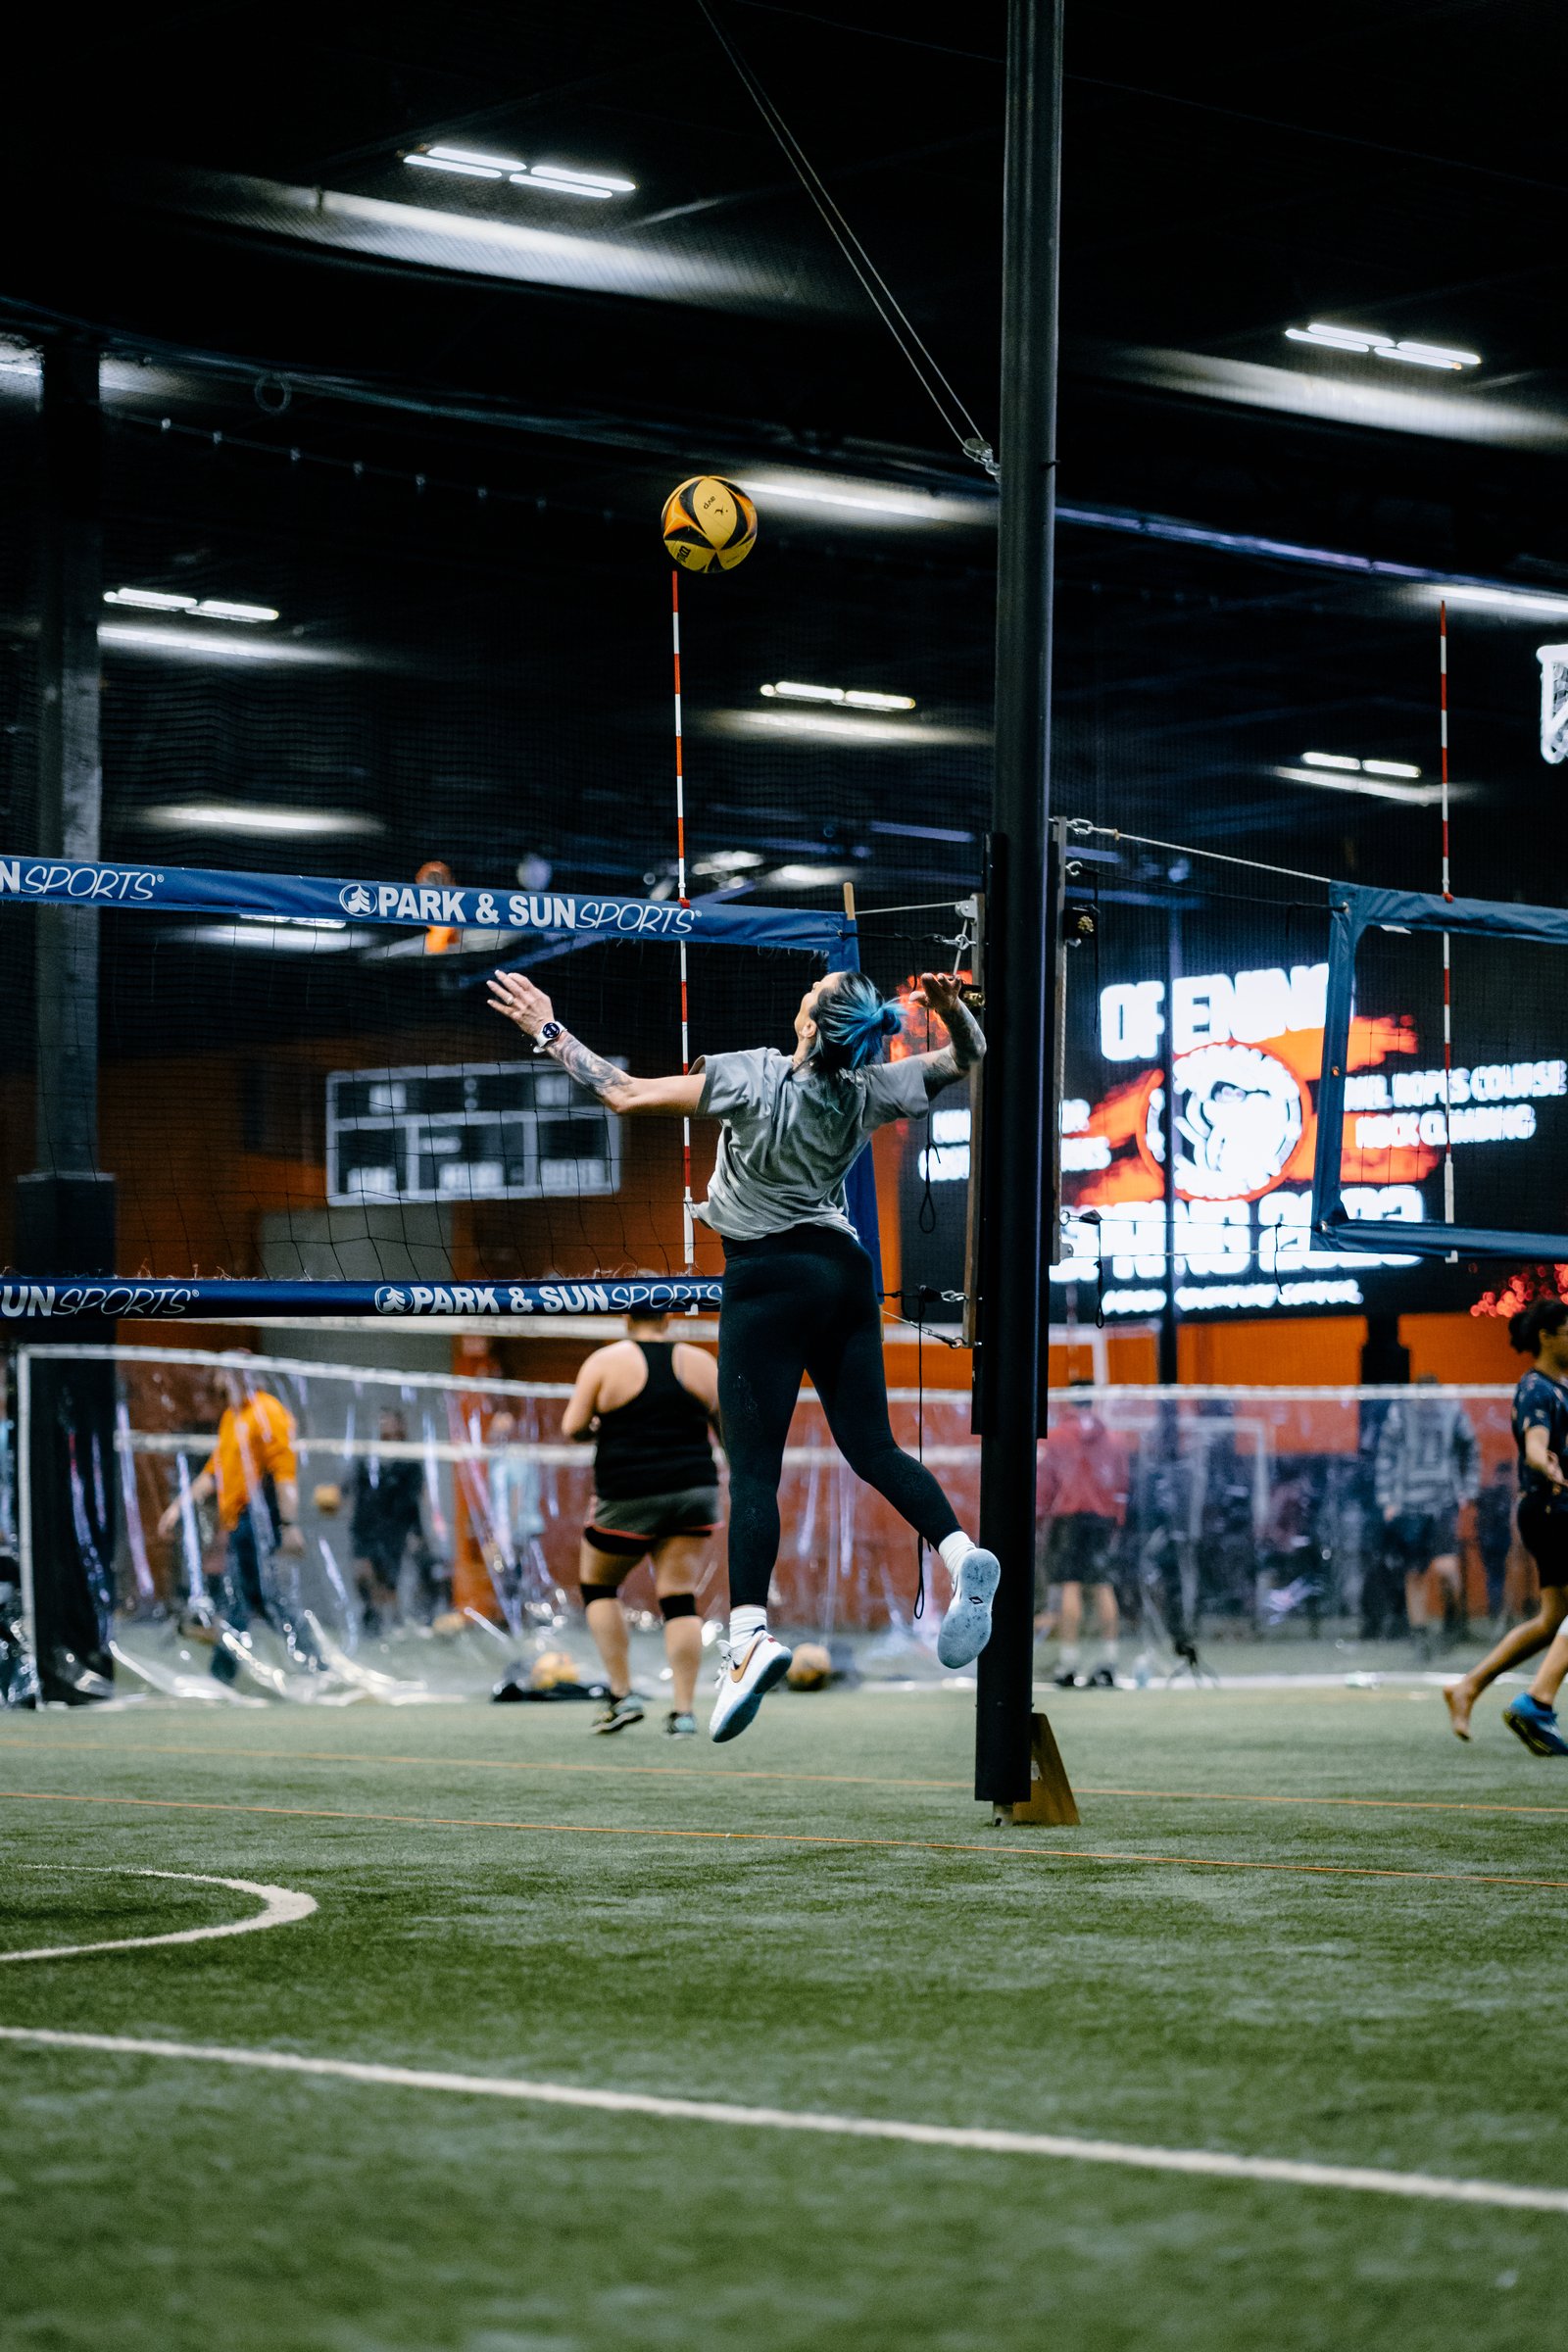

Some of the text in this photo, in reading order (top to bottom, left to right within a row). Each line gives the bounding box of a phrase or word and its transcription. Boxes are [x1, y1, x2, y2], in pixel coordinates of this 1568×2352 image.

[378, 886, 467, 923] PARK
[475, 893, 500, 924] &
[0, 1285, 56, 1317] UN
[410, 1286, 501, 1314] PARK
[508, 1286, 534, 1313] &
